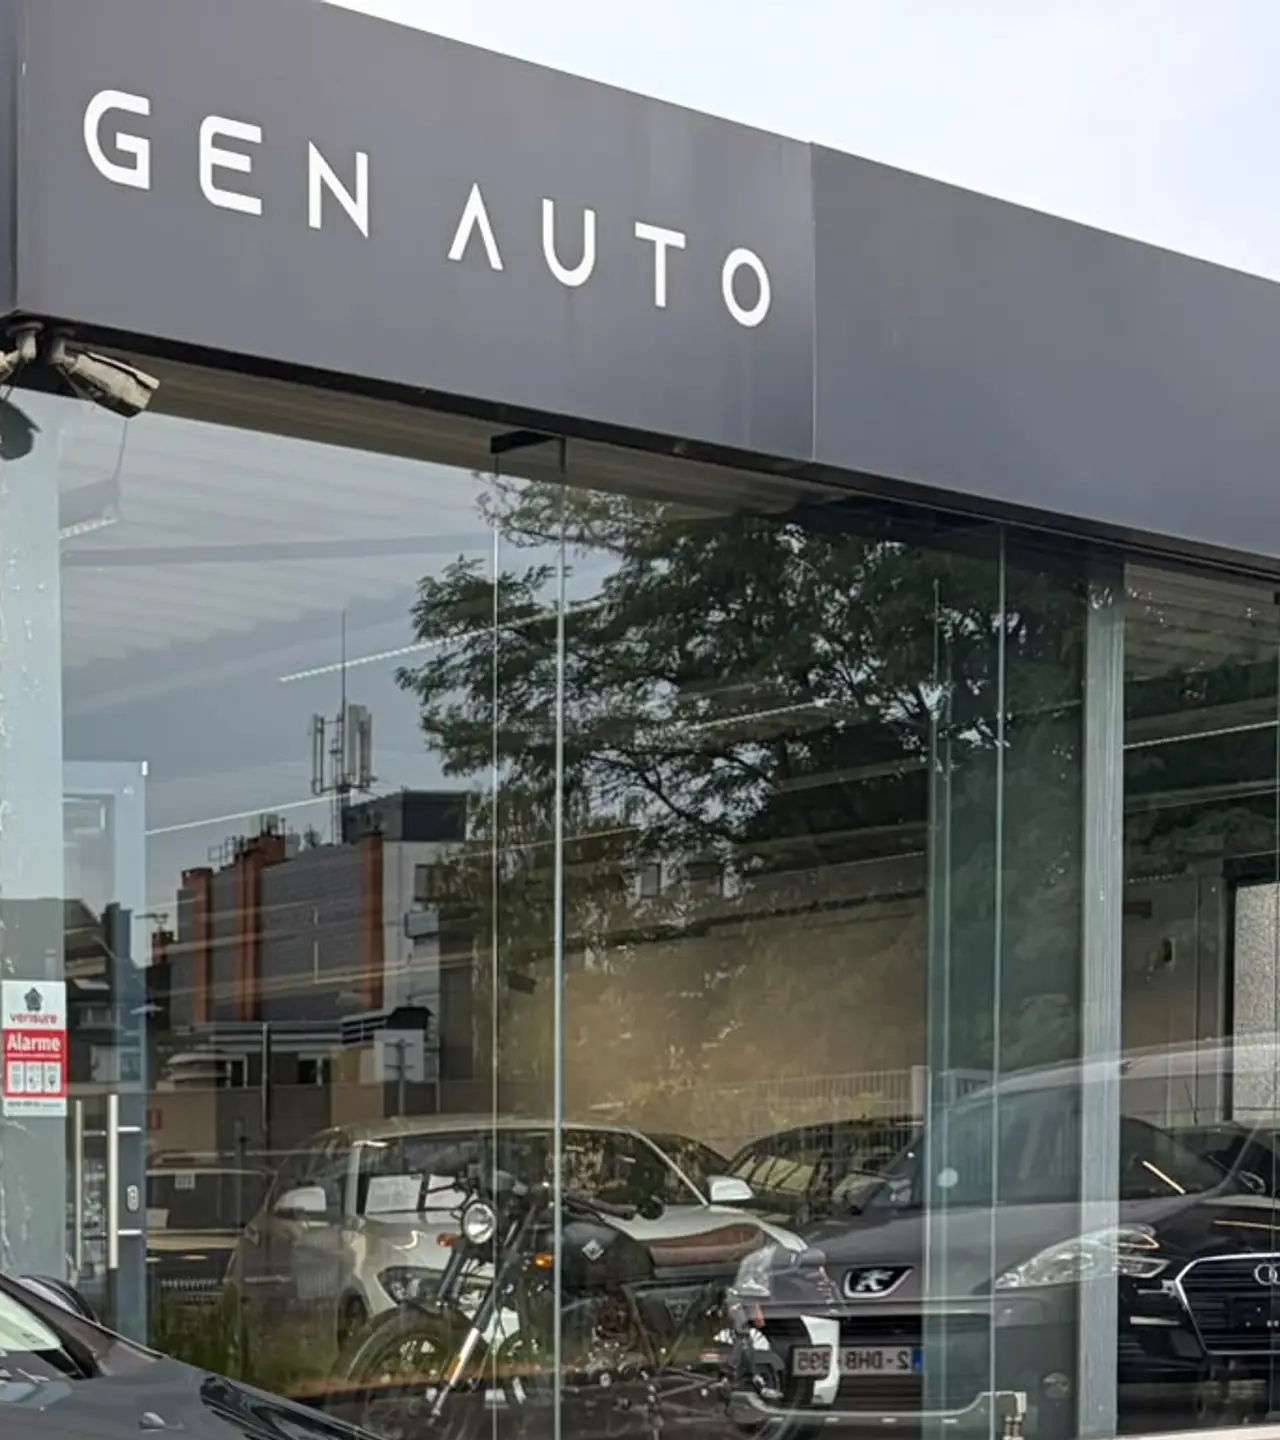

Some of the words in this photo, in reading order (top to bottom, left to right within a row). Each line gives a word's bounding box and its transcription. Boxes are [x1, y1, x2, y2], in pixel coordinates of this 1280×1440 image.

[83, 89, 369, 238] GEN
[448, 183, 771, 327] AUTO
[7, 1032, 61, 1051] Alarme
